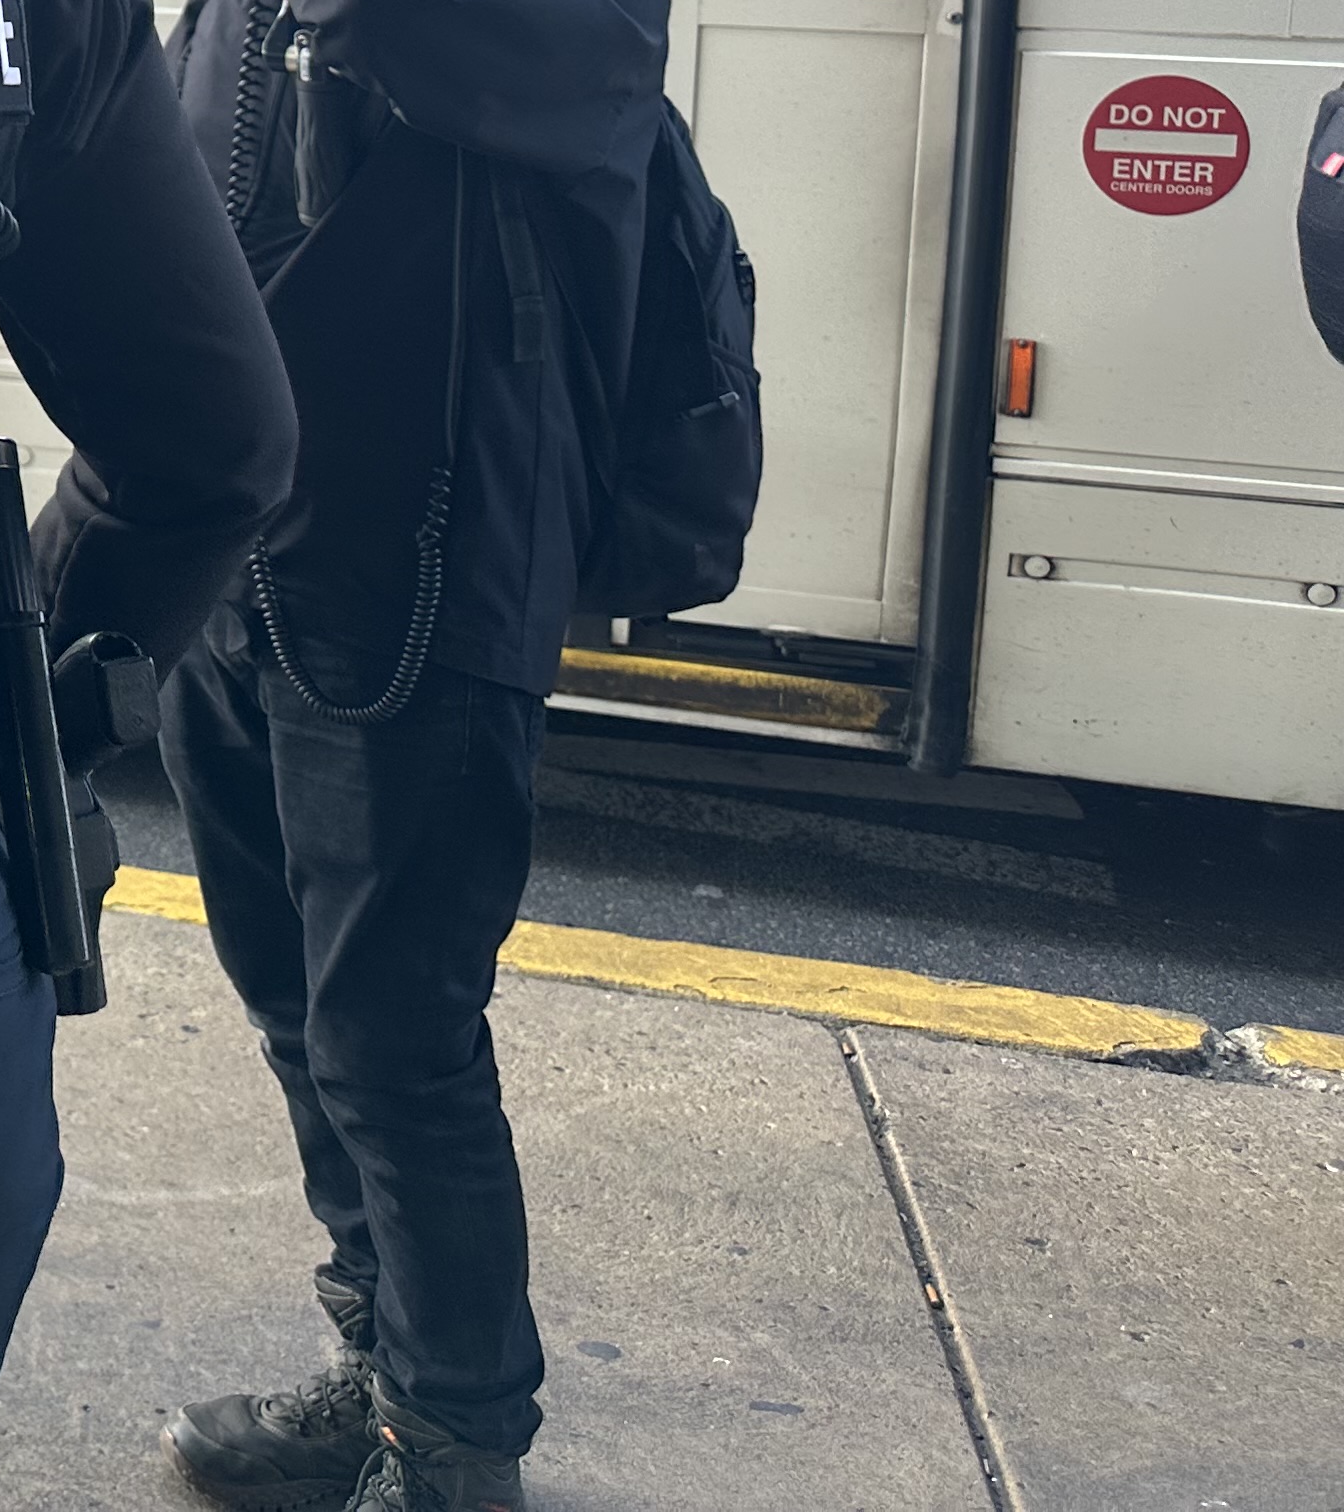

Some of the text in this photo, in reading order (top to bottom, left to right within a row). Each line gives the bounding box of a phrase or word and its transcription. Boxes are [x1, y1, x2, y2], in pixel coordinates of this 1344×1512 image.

[1109, 103, 1226, 129] DO NOT
[1112, 157, 1214, 184] ENTER
[1110, 180, 1213, 196] CENTER DOORS
